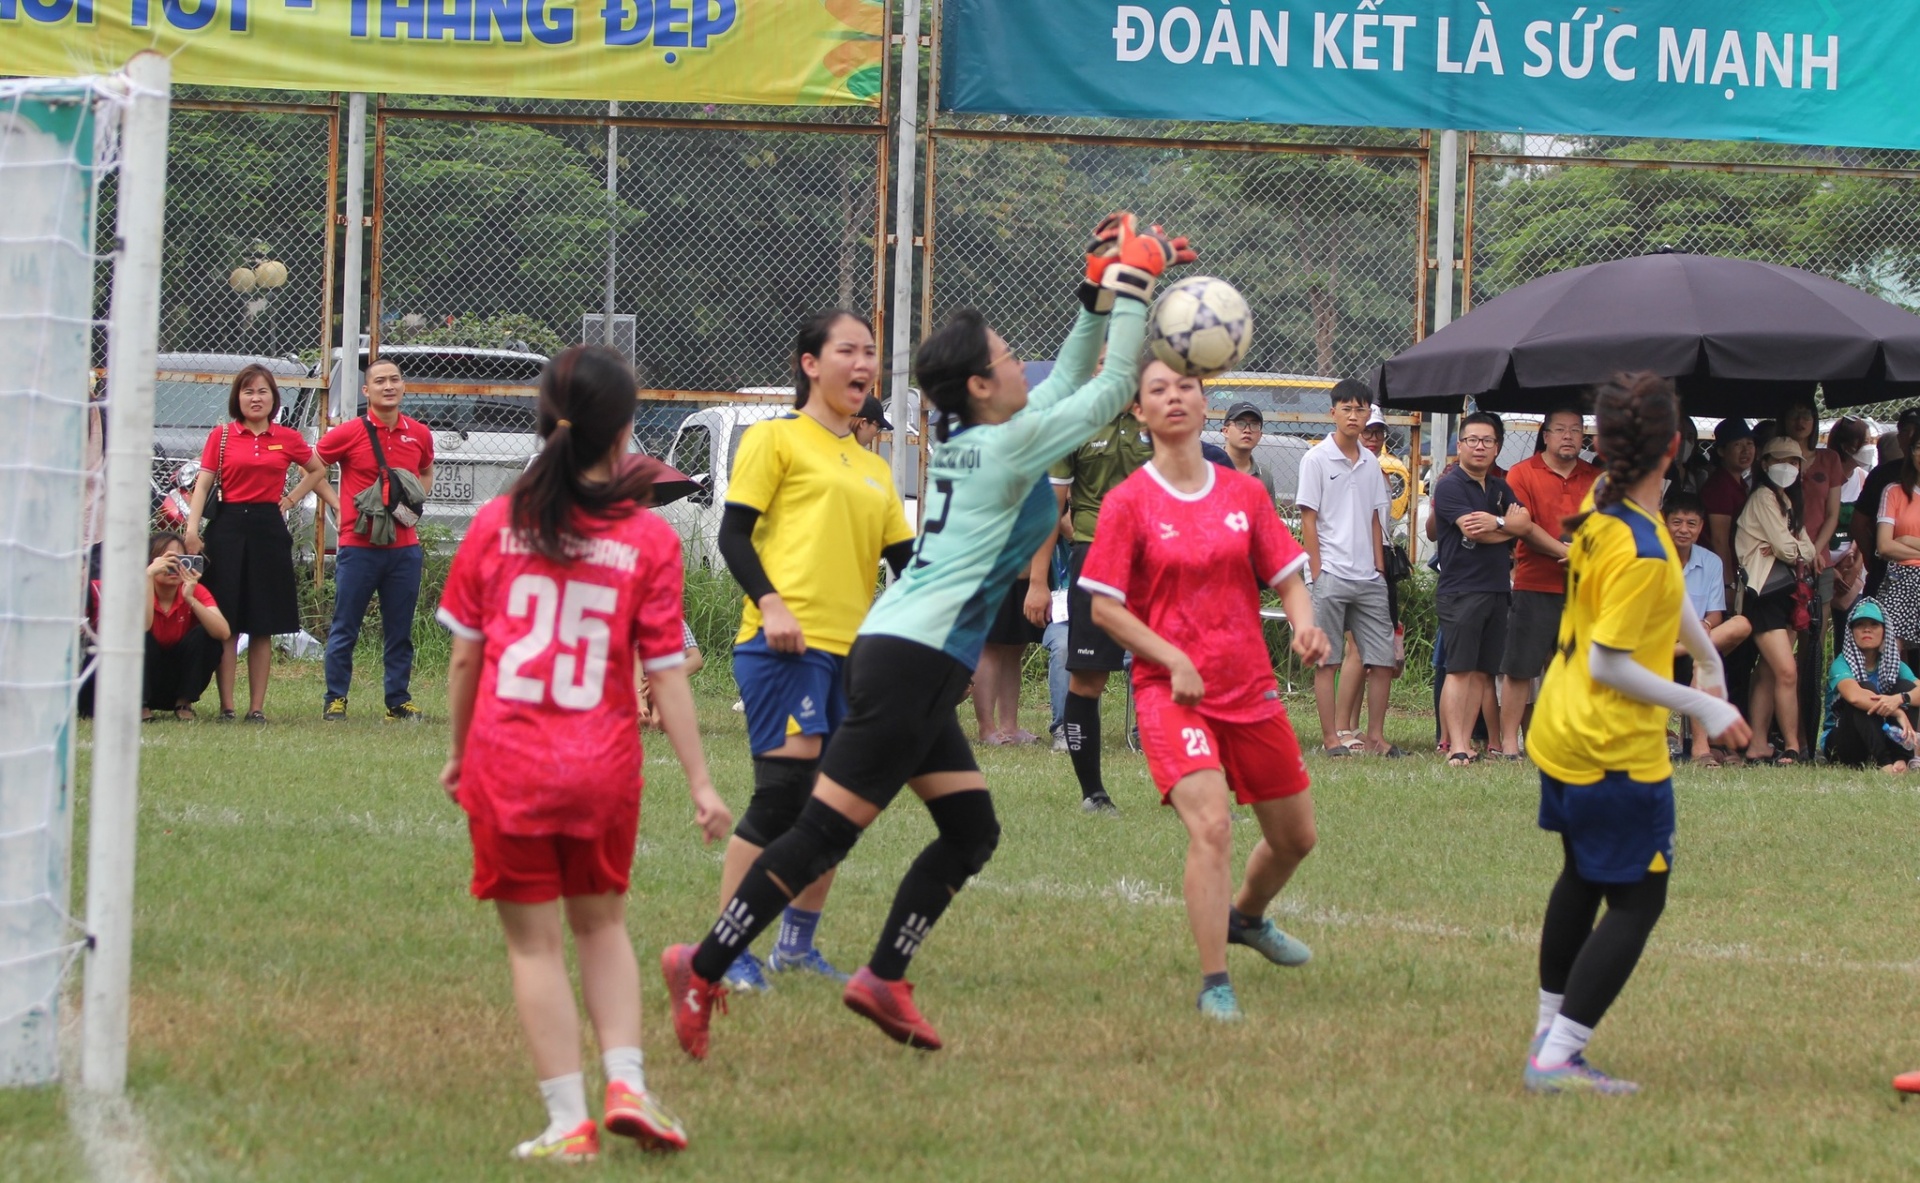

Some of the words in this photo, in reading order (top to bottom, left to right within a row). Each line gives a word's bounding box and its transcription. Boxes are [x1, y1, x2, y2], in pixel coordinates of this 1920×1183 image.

[601, 0, 736, 64] ĐẸP
[1112, 0, 1289, 67] ĐOÀN
[1313, 0, 1416, 71] KẾT
[1437, 1, 1504, 76] LÀ
[1523, 7, 1637, 81] SỨC
[1657, 27, 1838, 100] MẠNH
[435, 465, 462, 482] 29A
[495, 573, 619, 711] 25
[1077, 647, 1095, 656] mitre
[1067, 723, 1087, 751] mitre
